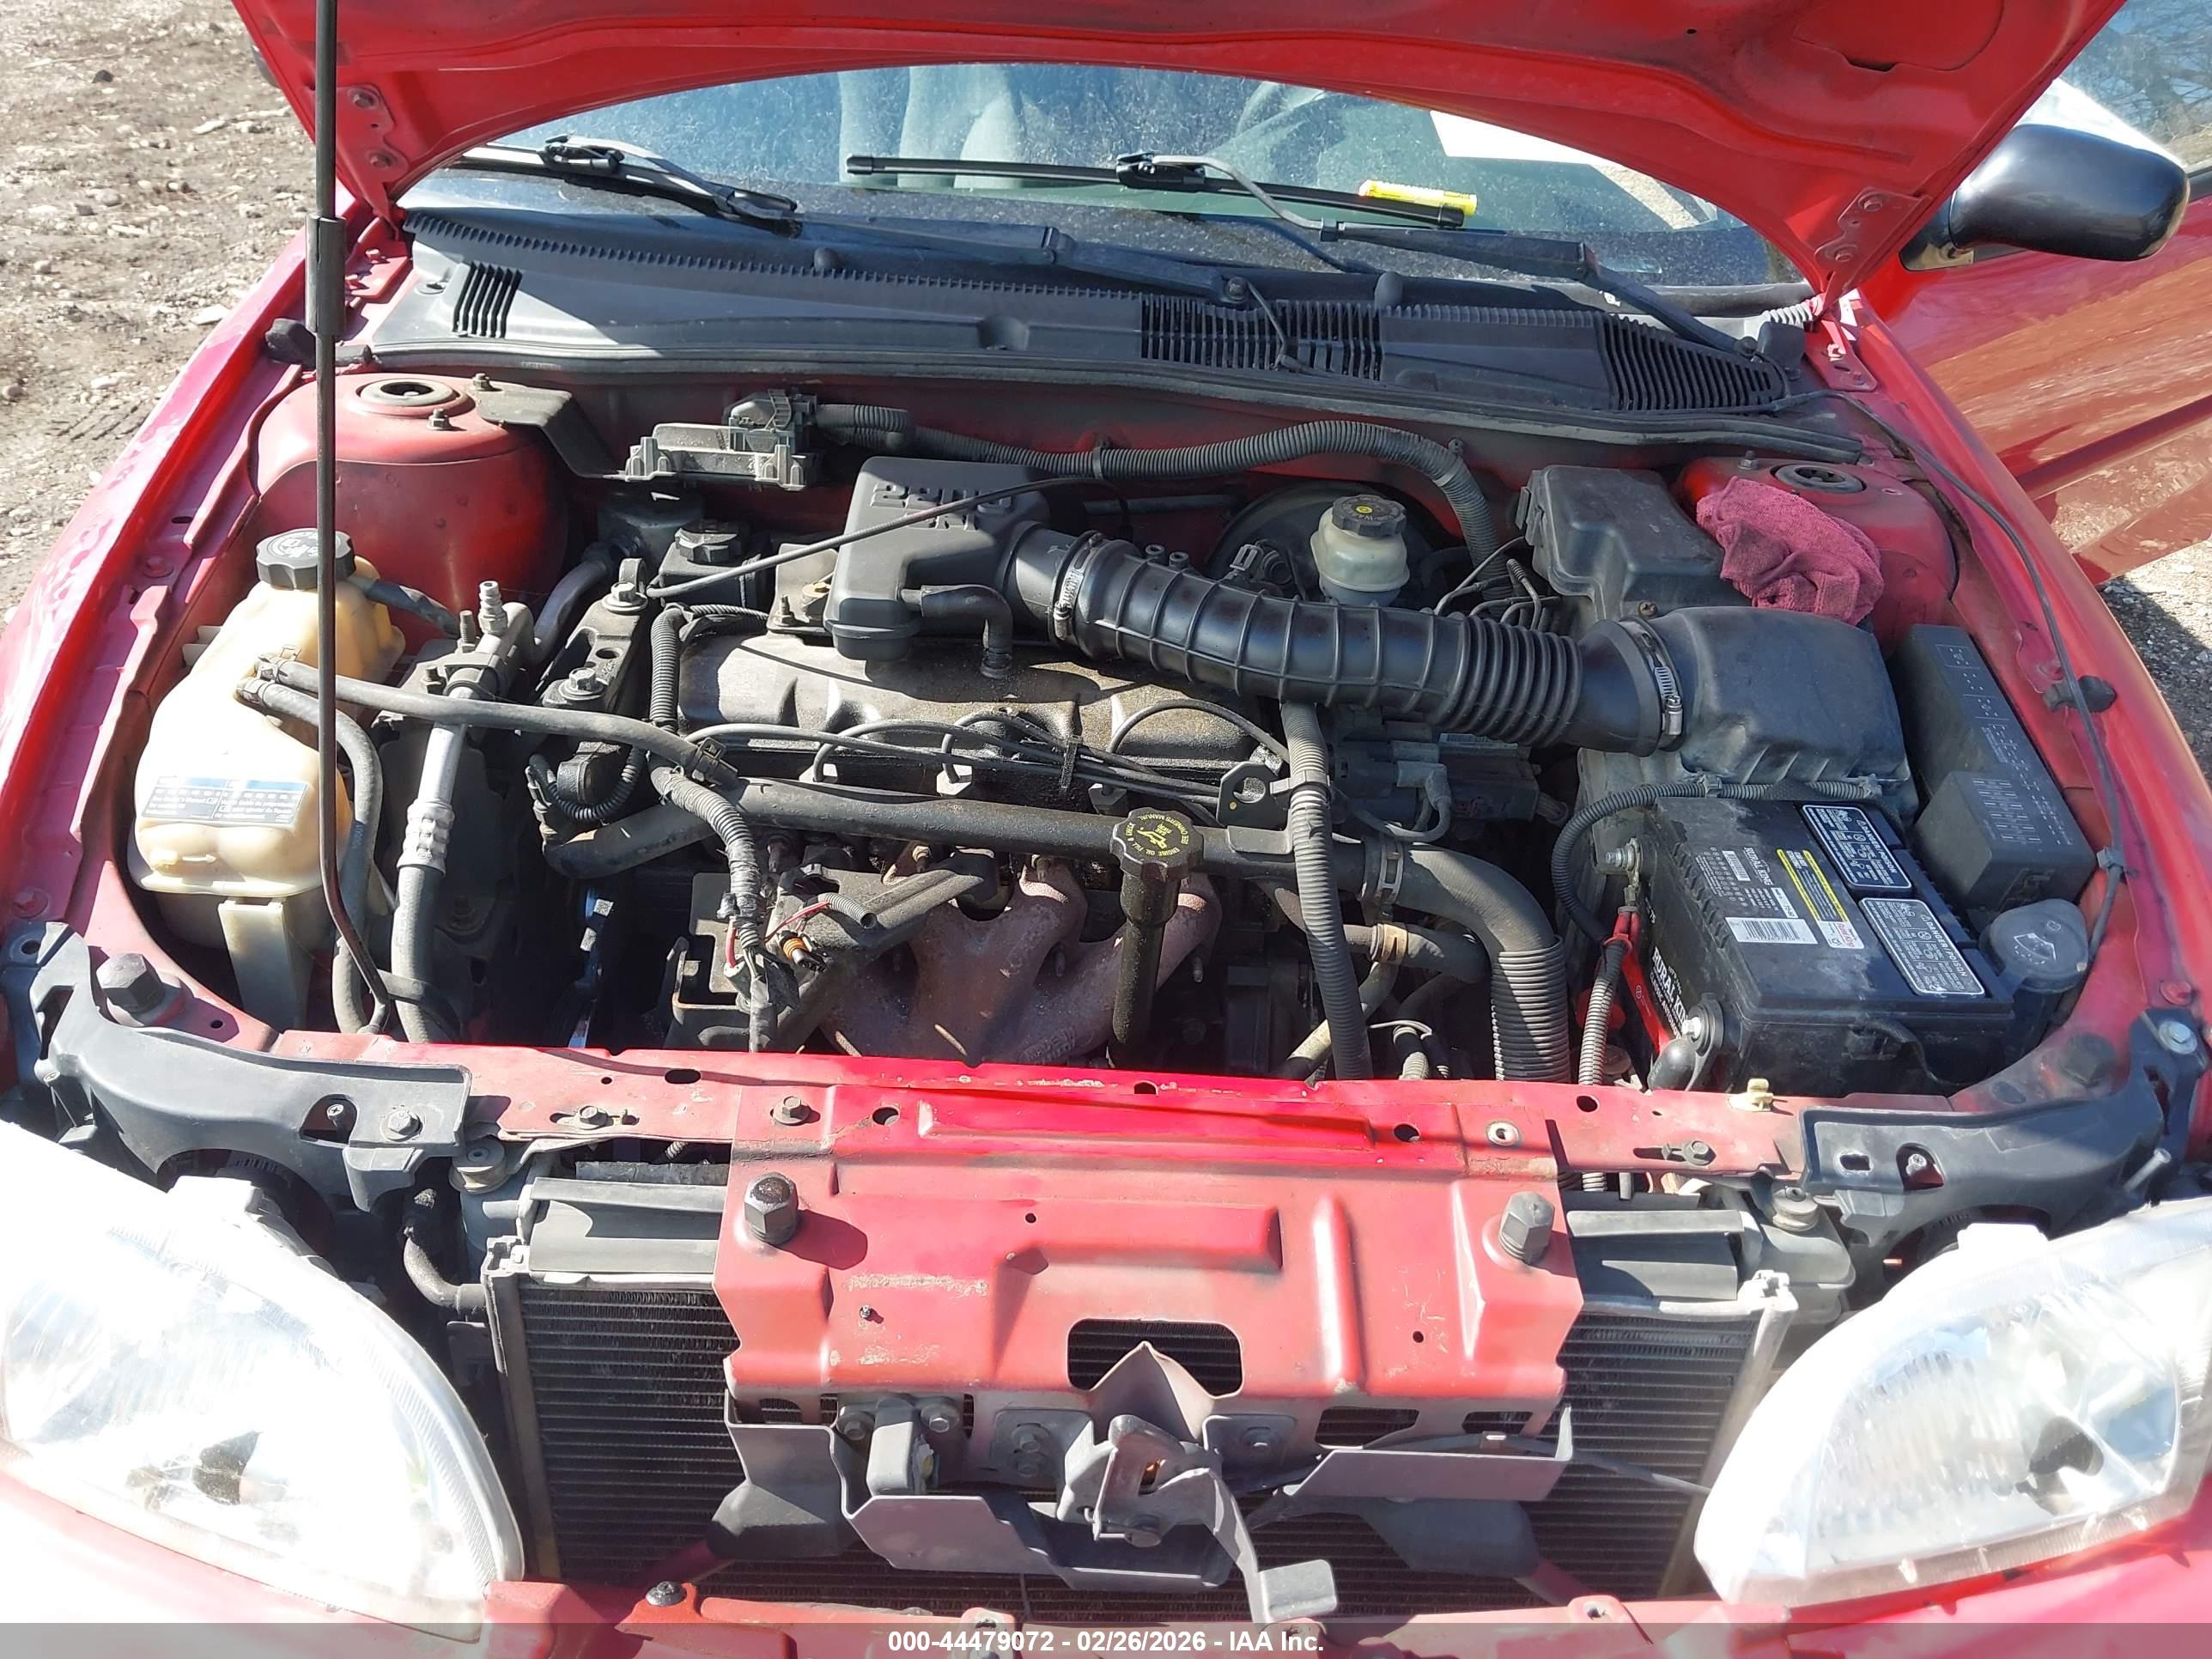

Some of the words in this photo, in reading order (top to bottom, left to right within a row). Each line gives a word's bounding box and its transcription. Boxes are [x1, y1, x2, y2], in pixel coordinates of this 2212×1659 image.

[1132, 842, 1144, 852] FILL
[1158, 847, 1181, 856] ENGINE
[1744, 847, 1763, 869] RURAL
[1758, 870, 1774, 885] KING
[1925, 921, 1967, 976] DANGER/POISON
[1650, 971, 1663, 1003] CLASSIC
[1652, 945, 1674, 1003] RURAL
[1674, 994, 1689, 1025] KIN
